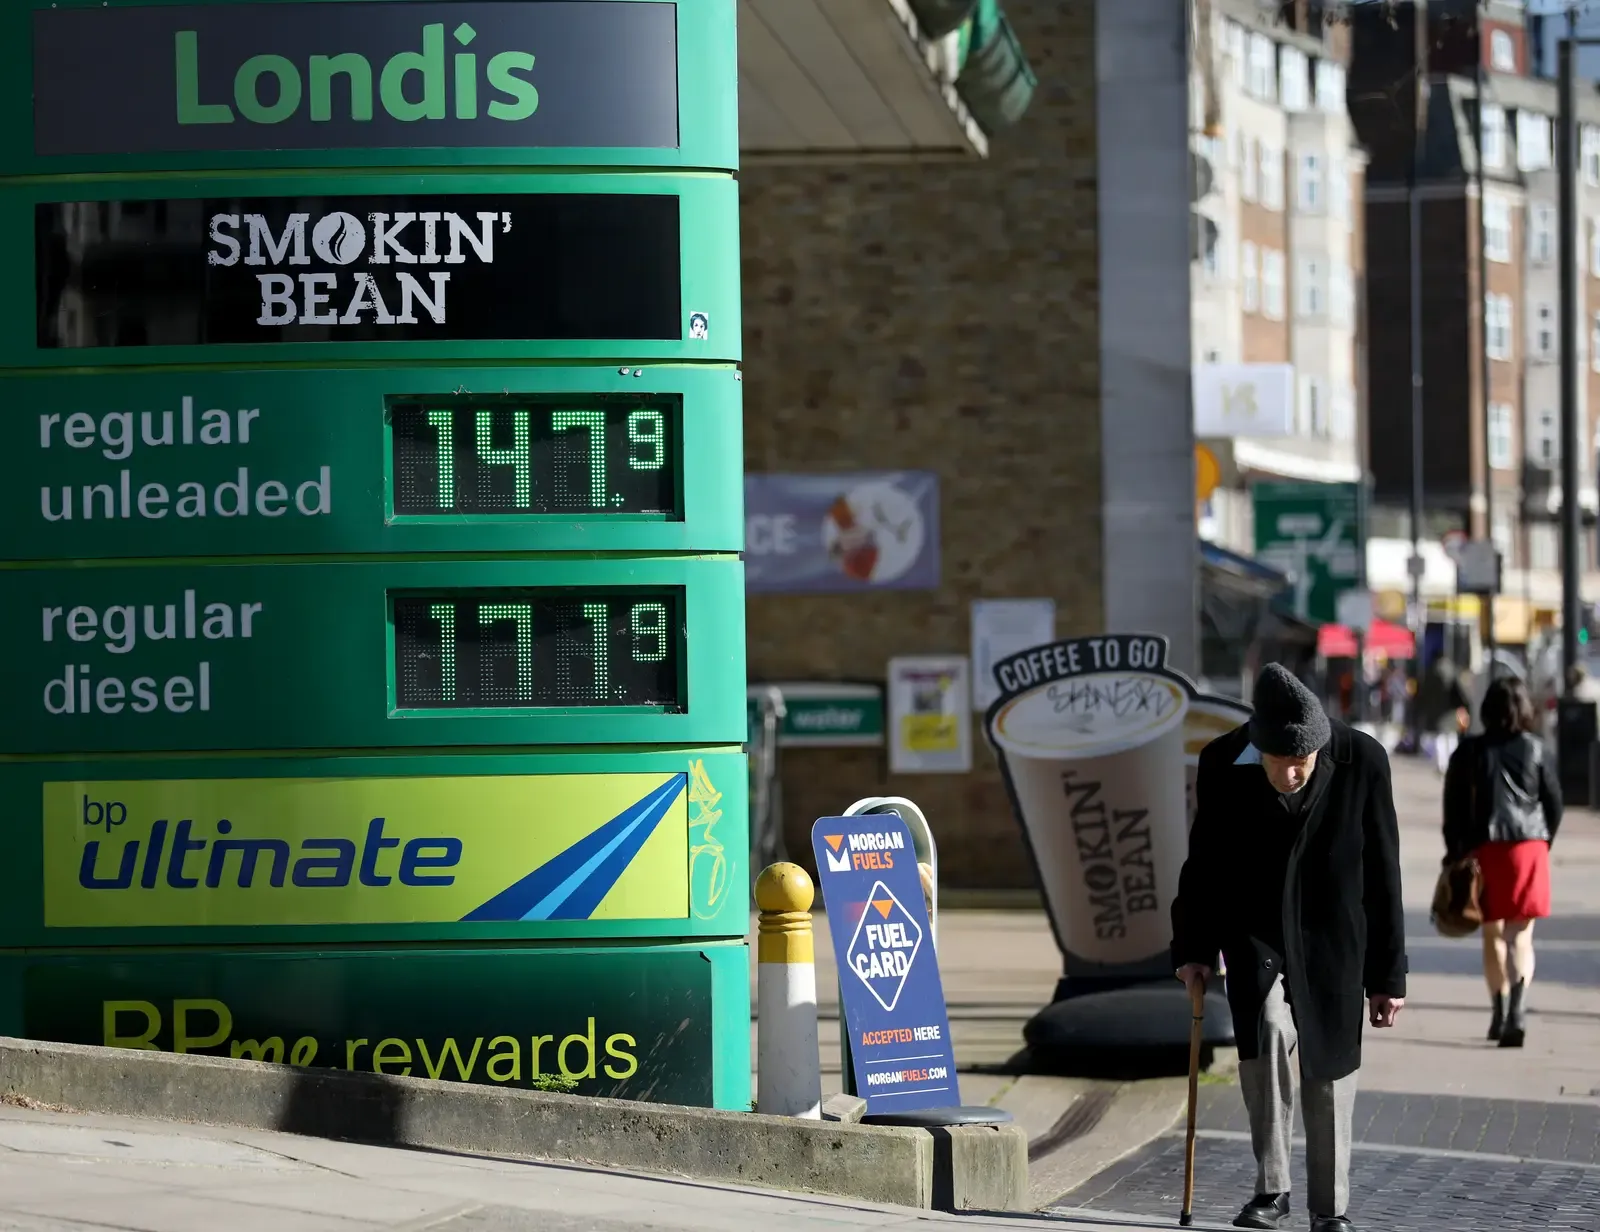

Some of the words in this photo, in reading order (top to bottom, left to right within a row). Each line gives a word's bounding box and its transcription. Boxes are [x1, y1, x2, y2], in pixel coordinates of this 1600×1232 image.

[175, 23, 540, 125] Londis
[208, 211, 512, 266] SMOKIN'
[256, 272, 451, 326] BEAN
[39, 397, 261, 460] regular
[427, 411, 665, 508] 147.9
[40, 466, 332, 522] unleaded
[42, 590, 262, 653] regular
[431, 603, 667, 701] 171.9
[1000, 643, 1082, 692] COFFEE
[1088, 639, 1120, 669] TO
[1128, 638, 1159, 669] GO
[43, 662, 212, 715] diesel
[82, 795, 127, 833] bp
[848, 832, 904, 851] MORGAN
[78, 818, 463, 889] ultimate
[852, 851, 894, 870] FUELS
[1060, 770, 1127, 940] SMOKIN'
[1112, 807, 1158, 915] BEAN
[865, 923, 914, 949] FUEL
[856, 950, 908, 979] CARD
[346, 1017, 638, 1081] rewards
[862, 1028, 913, 1045] ACCEPTED
[913, 1026, 941, 1041] HERE
[867, 1066, 947, 1085] MORGANFUELS.COM
